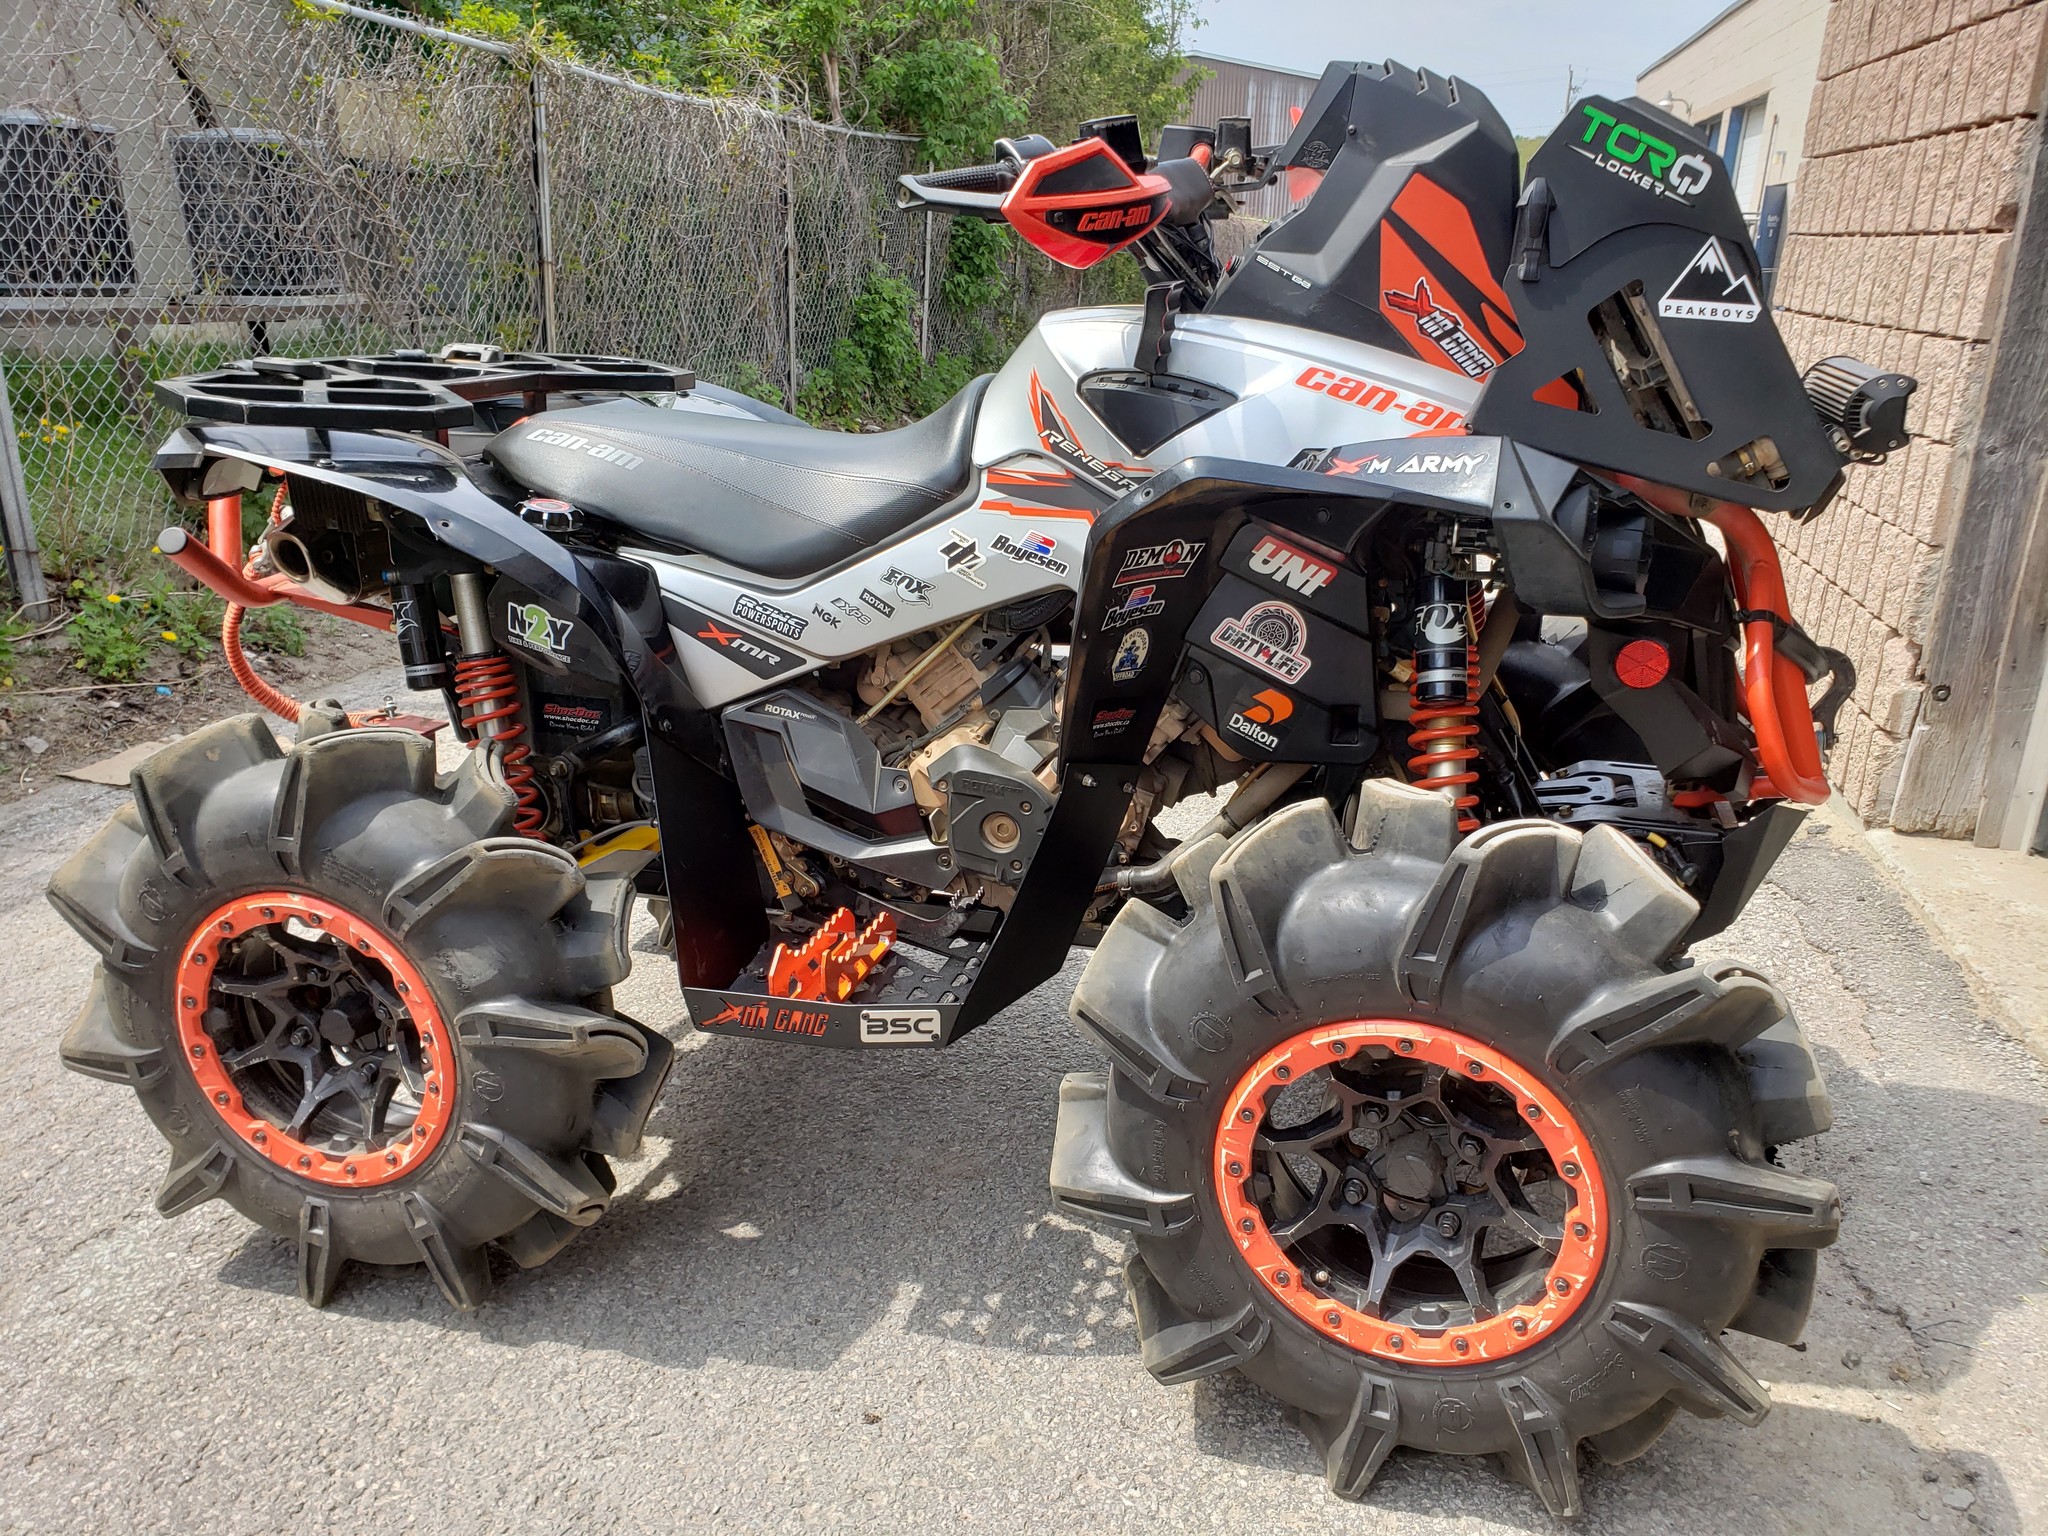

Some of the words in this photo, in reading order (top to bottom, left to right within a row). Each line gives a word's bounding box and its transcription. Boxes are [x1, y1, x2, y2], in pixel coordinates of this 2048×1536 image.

[1581, 105, 1713, 197] TORQ
[1594, 154, 1666, 197] LOCKER
[1077, 204, 1152, 233] can-am
[1663, 303, 1756, 321] PEAKBOYS
[1439, 331, 1494, 377] GANG
[526, 428, 646, 471] can-am
[1039, 429, 1139, 493] RENEGA
[1396, 453, 1487, 476] ARMY
[990, 534, 1068, 576] Boyesen
[1121, 539, 1205, 570] DEMON
[1248, 541, 1333, 598] UNI
[881, 566, 936, 603] FOX
[735, 603, 801, 639] POWERSPORTS
[811, 605, 842, 630] NGK
[862, 592, 892, 615] ROTAX
[1102, 602, 1163, 630] Boyesen
[508, 601, 574, 650] N2Y
[1414, 603, 1467, 645] FOX
[507, 635, 523, 647] TIRE
[528, 641, 571, 664] PERFORMANCE
[1218, 624, 1268, 660] DIRTY
[1264, 649, 1303, 678] LIFE
[543, 714, 600, 726] www.shocdoc.ca
[764, 703, 801, 720] ROTAX
[1228, 712, 1279, 749] Dalton
[773, 1007, 830, 1038] GANG
[866, 1016, 935, 1036] BSC
